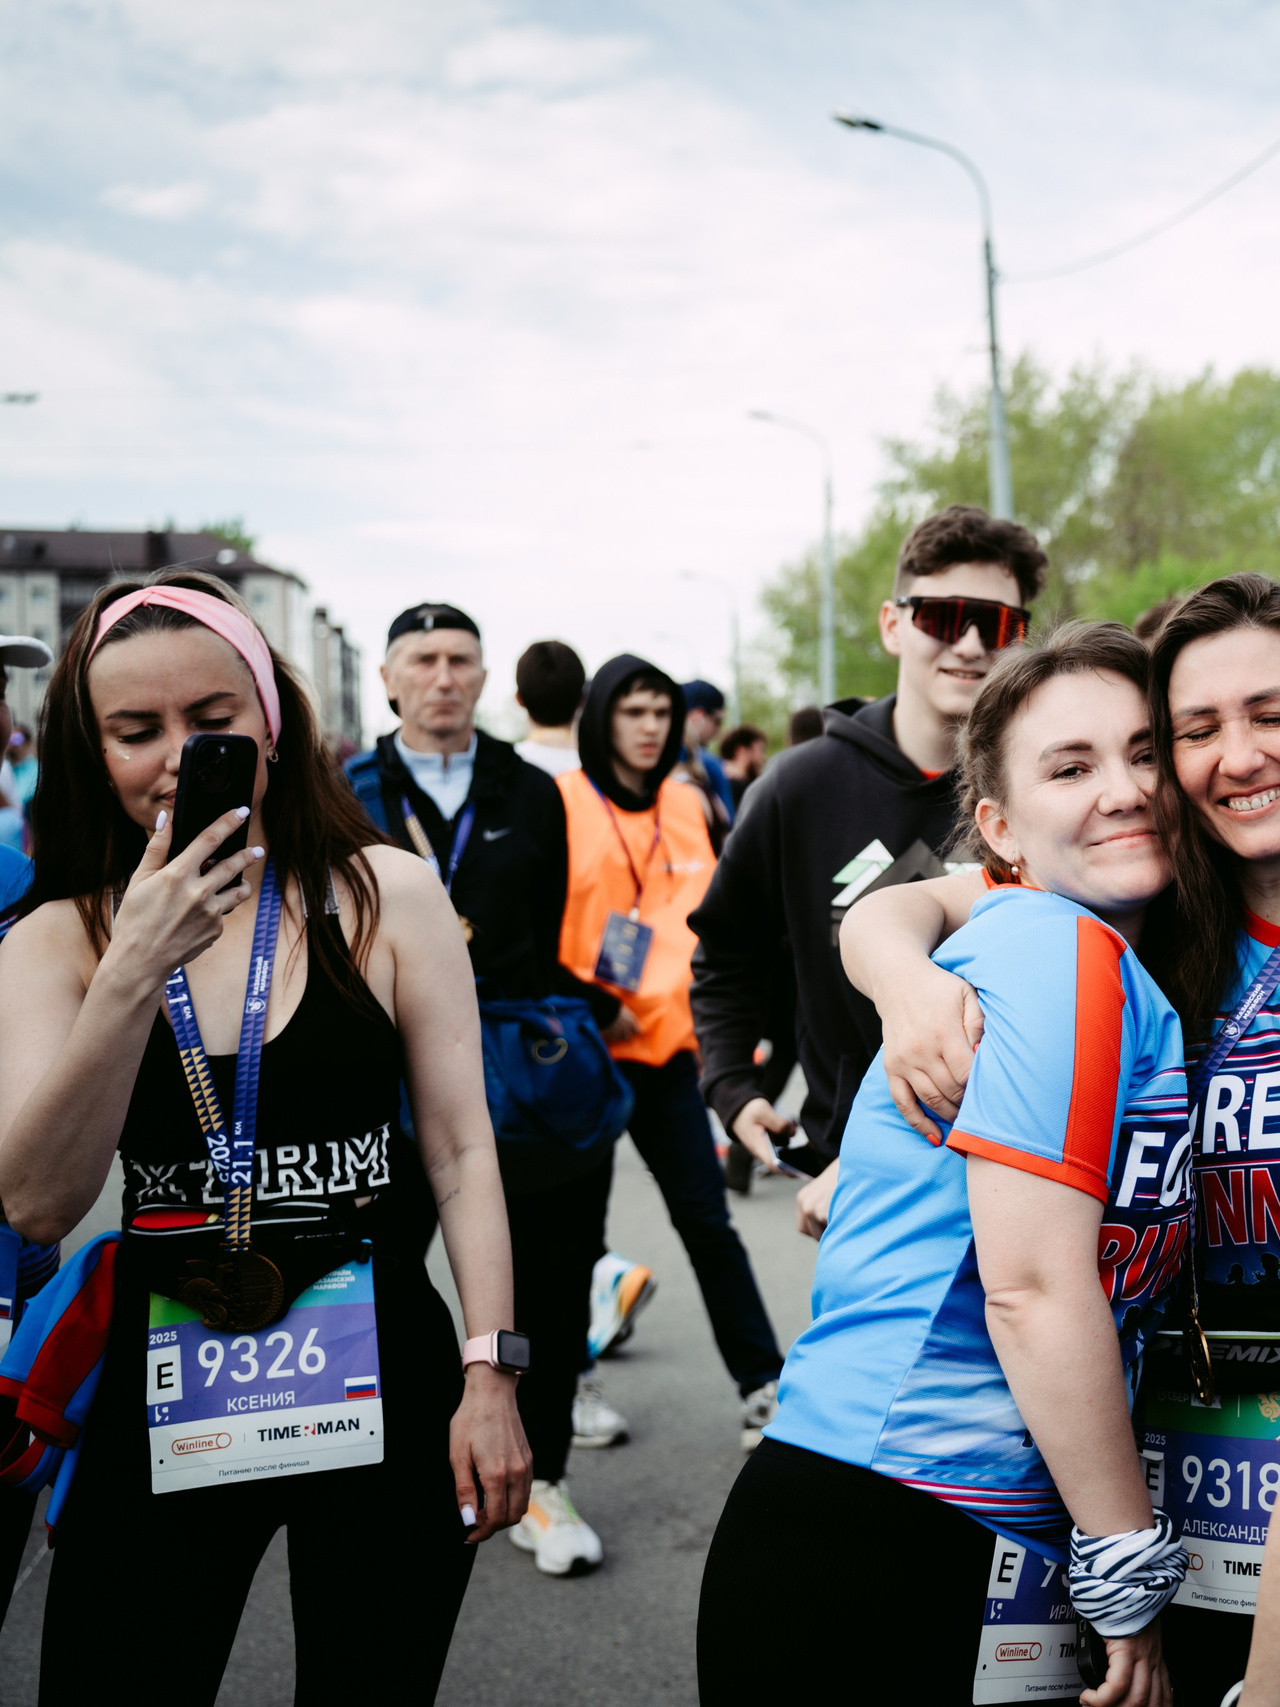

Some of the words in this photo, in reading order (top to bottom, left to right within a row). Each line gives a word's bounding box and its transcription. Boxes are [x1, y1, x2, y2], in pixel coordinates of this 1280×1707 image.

[1235, 983, 1263, 1020] КАЗАНСКИЙ
[1243, 990, 1266, 1020] МАРАФОН
[227, 1141, 253, 1184] 21.1
[149, 1331, 178, 1345] 2025
[197, 1328, 326, 1388] 9326
[157, 1362, 174, 1390] E
[227, 1390, 296, 1413] КСЕНИЯ
[176, 1437, 214, 1452] Winline
[1144, 1432, 1166, 1445] 2025
[219, 1466, 251, 1477] Питание
[253, 1463, 277, 1474] после
[279, 1459, 310, 1472] финиша
[997, 1552, 1018, 1583] E
[1191, 1592, 1218, 1603] Питание
[1218, 1597, 1239, 1606] после
[1000, 1648, 1028, 1658] Winline
[1025, 1684, 1047, 1693] Питание
[1048, 1683, 1063, 1691] после
